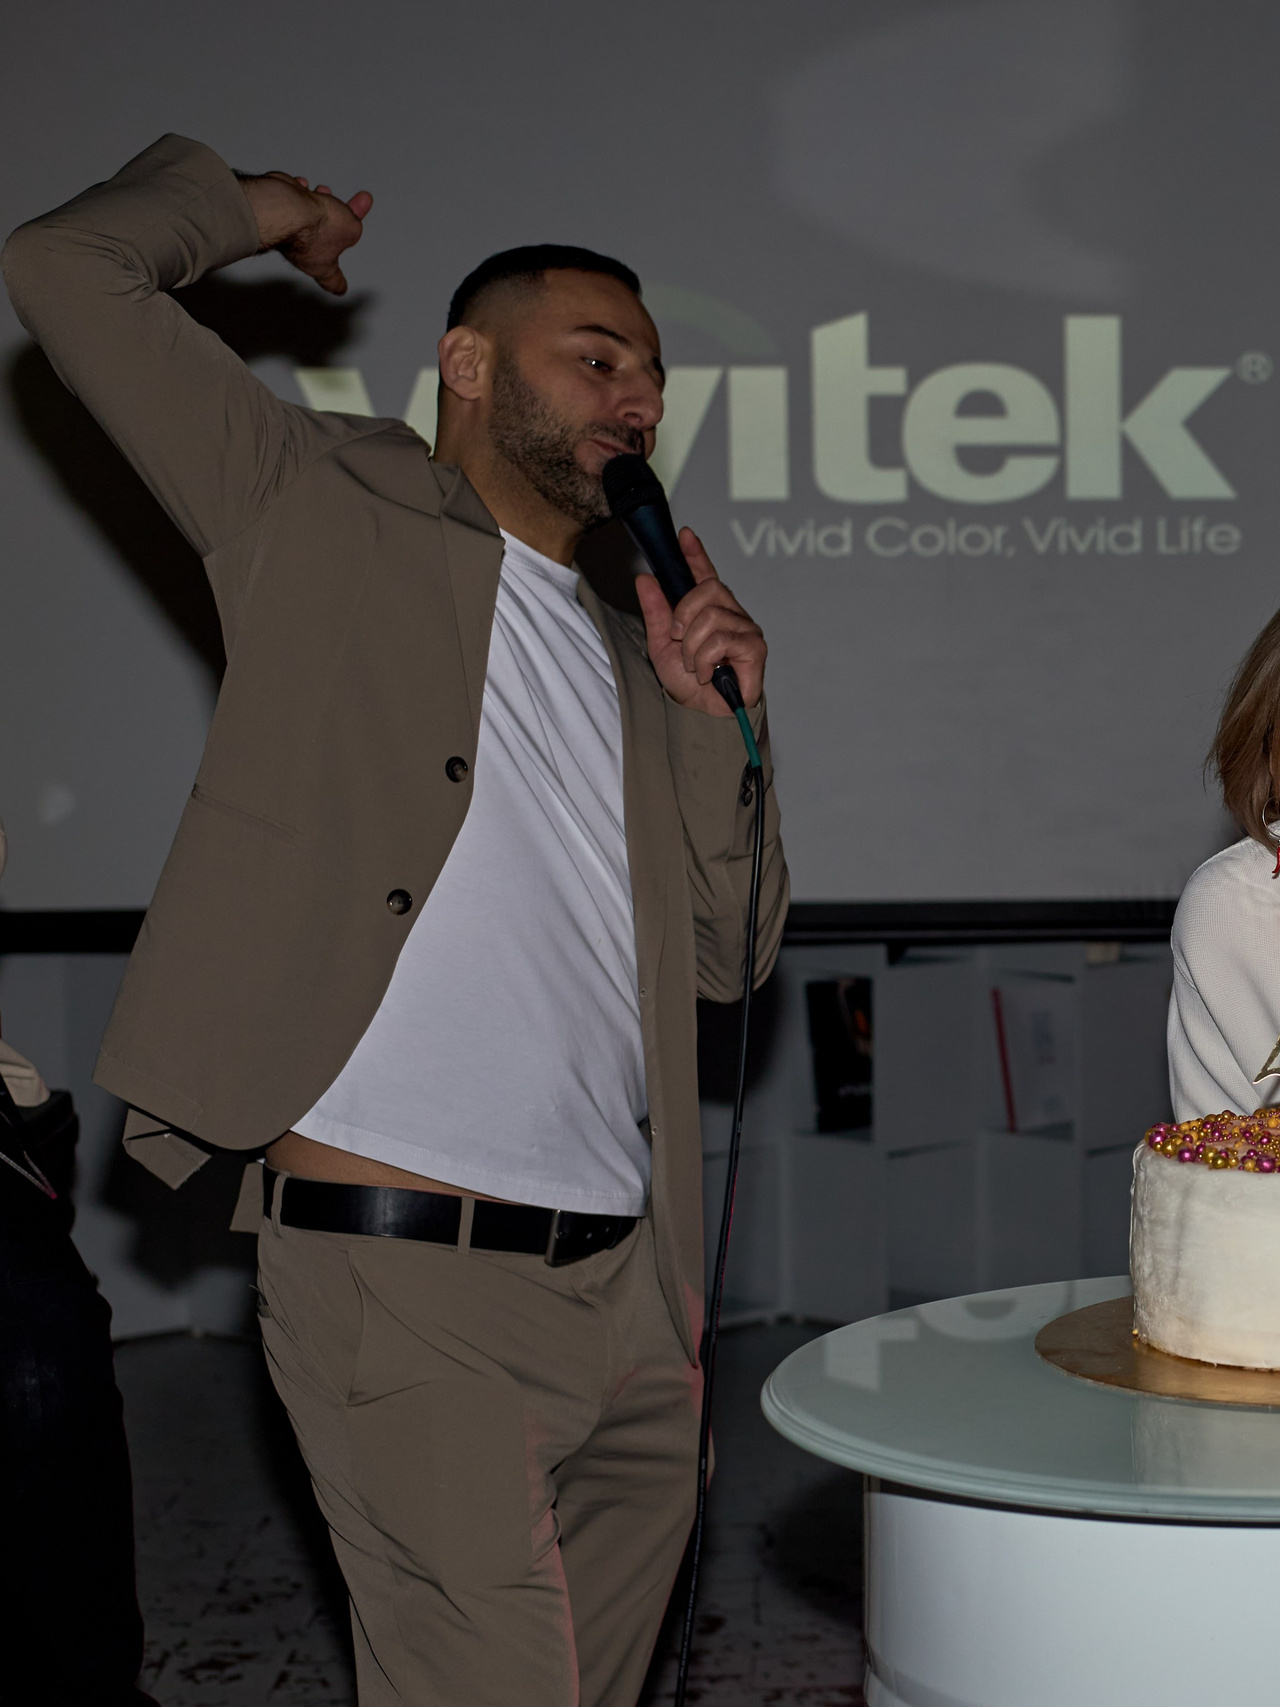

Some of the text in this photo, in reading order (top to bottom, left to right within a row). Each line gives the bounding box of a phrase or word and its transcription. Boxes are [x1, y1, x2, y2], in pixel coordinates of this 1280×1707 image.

[731, 515, 1242, 559] Vivid Color, Vivid Life
